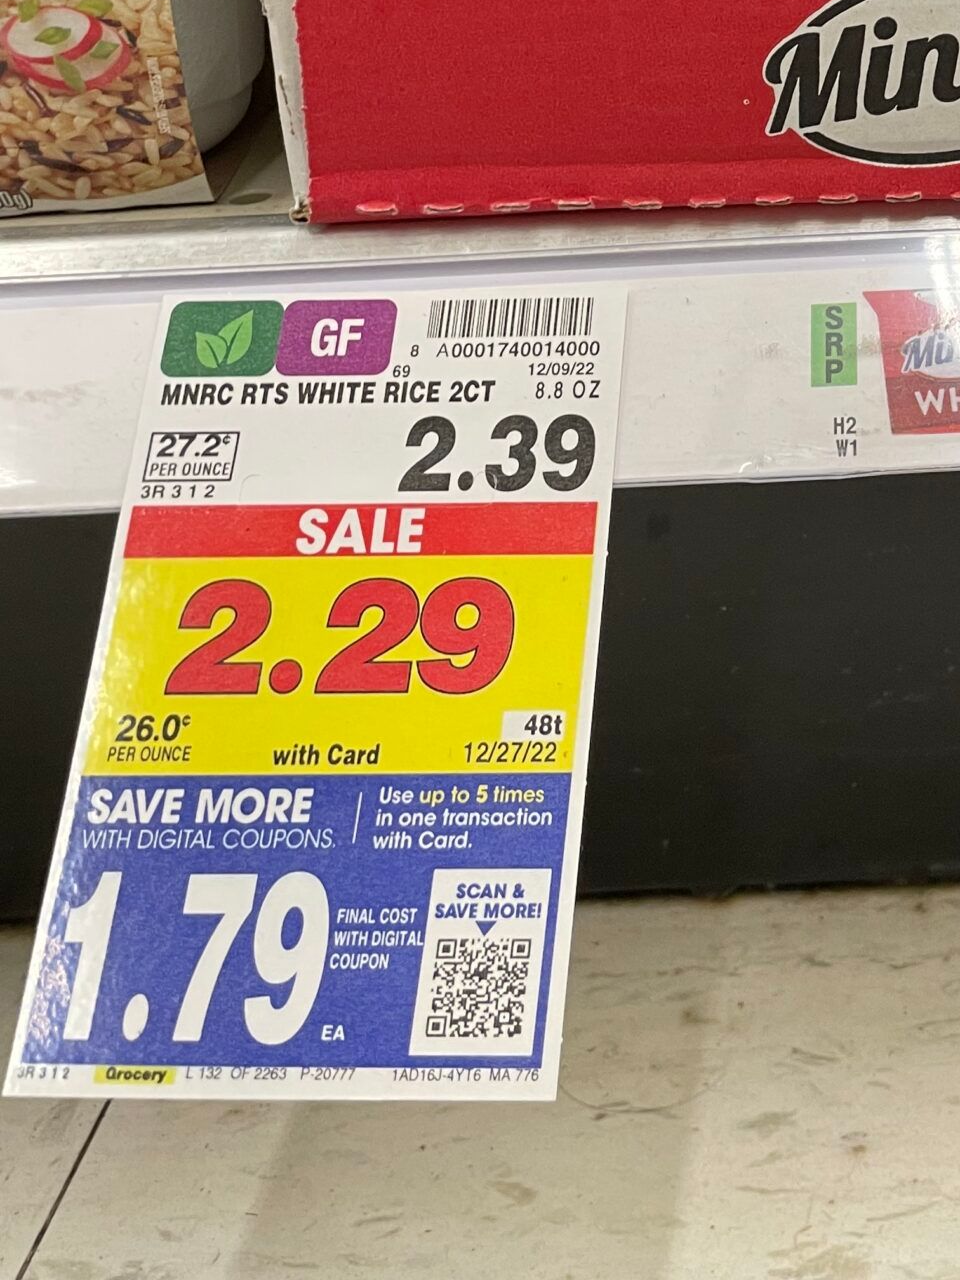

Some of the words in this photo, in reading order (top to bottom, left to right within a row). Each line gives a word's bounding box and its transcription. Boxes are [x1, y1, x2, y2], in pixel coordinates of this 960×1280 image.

[311, 317, 366, 358] GF
[410, 344, 420, 357] 8
[436, 341, 600, 358] A0001740014000
[392, 365, 411, 378] 69
[528, 362, 595, 377] 12/09/22
[161, 382, 233, 406] MNRC
[241, 382, 289, 405] RTS
[298, 381, 376, 405] WHITE
[383, 380, 442, 404] RICE
[449, 379, 496, 403] 2CT
[535, 381, 563, 400] 8.8
[833, 416, 857, 435] H2
[397, 413, 597, 494] 2.39
[836, 439, 858, 457] W1
[149, 462, 178, 477] PER
[182, 462, 231, 477] OUNCE
[295, 506, 426, 555] SALE
[164, 576, 516, 695] 2.29
[523, 714, 563, 736] 48t
[107, 745, 140, 762] PER
[142, 745, 192, 762] OUNCE
[272, 743, 321, 766] with
[326, 743, 380, 766] Card
[463, 741, 557, 763] 12/27/22
[379, 786, 414, 804] Use
[419, 790, 445, 807] up
[451, 786, 470, 803] to
[476, 784, 489, 803] 5
[493, 785, 545, 803] times
[87, 788, 185, 823] SAVE
[195, 788, 315, 823] MORE
[375, 809, 392, 826] in
[399, 811, 437, 827] one
[442, 808, 553, 827] transaction
[82, 828, 131, 849] WITH
[137, 828, 215, 849] DIGITAL
[222, 828, 336, 849] COUPONS.
[373, 831, 412, 849] with
[418, 831, 473, 849] Card.
[456, 883, 507, 899] SCAN
[511, 883, 525, 898] &
[336, 908, 376, 924] FINAL
[379, 907, 418, 924] COST
[434, 903, 478, 919] SAVE
[483, 902, 542, 919] MORE!
[334, 930, 368, 946] WITH
[371, 930, 424, 946] DIGITAL
[62, 870, 330, 1045] 1.79
[330, 953, 389, 969] COUPON
[320, 1024, 345, 1041] EA
[105, 1065, 168, 1084] Grocery
[185, 1067, 194, 1079] L
[199, 1067, 223, 1080] 132
[230, 1066, 250, 1080] OF
[253, 1066, 288, 1080] 2263
[300, 1068, 356, 1080] P-20777
[488, 1068, 511, 1081] MA
[515, 1068, 540, 1081] 776
